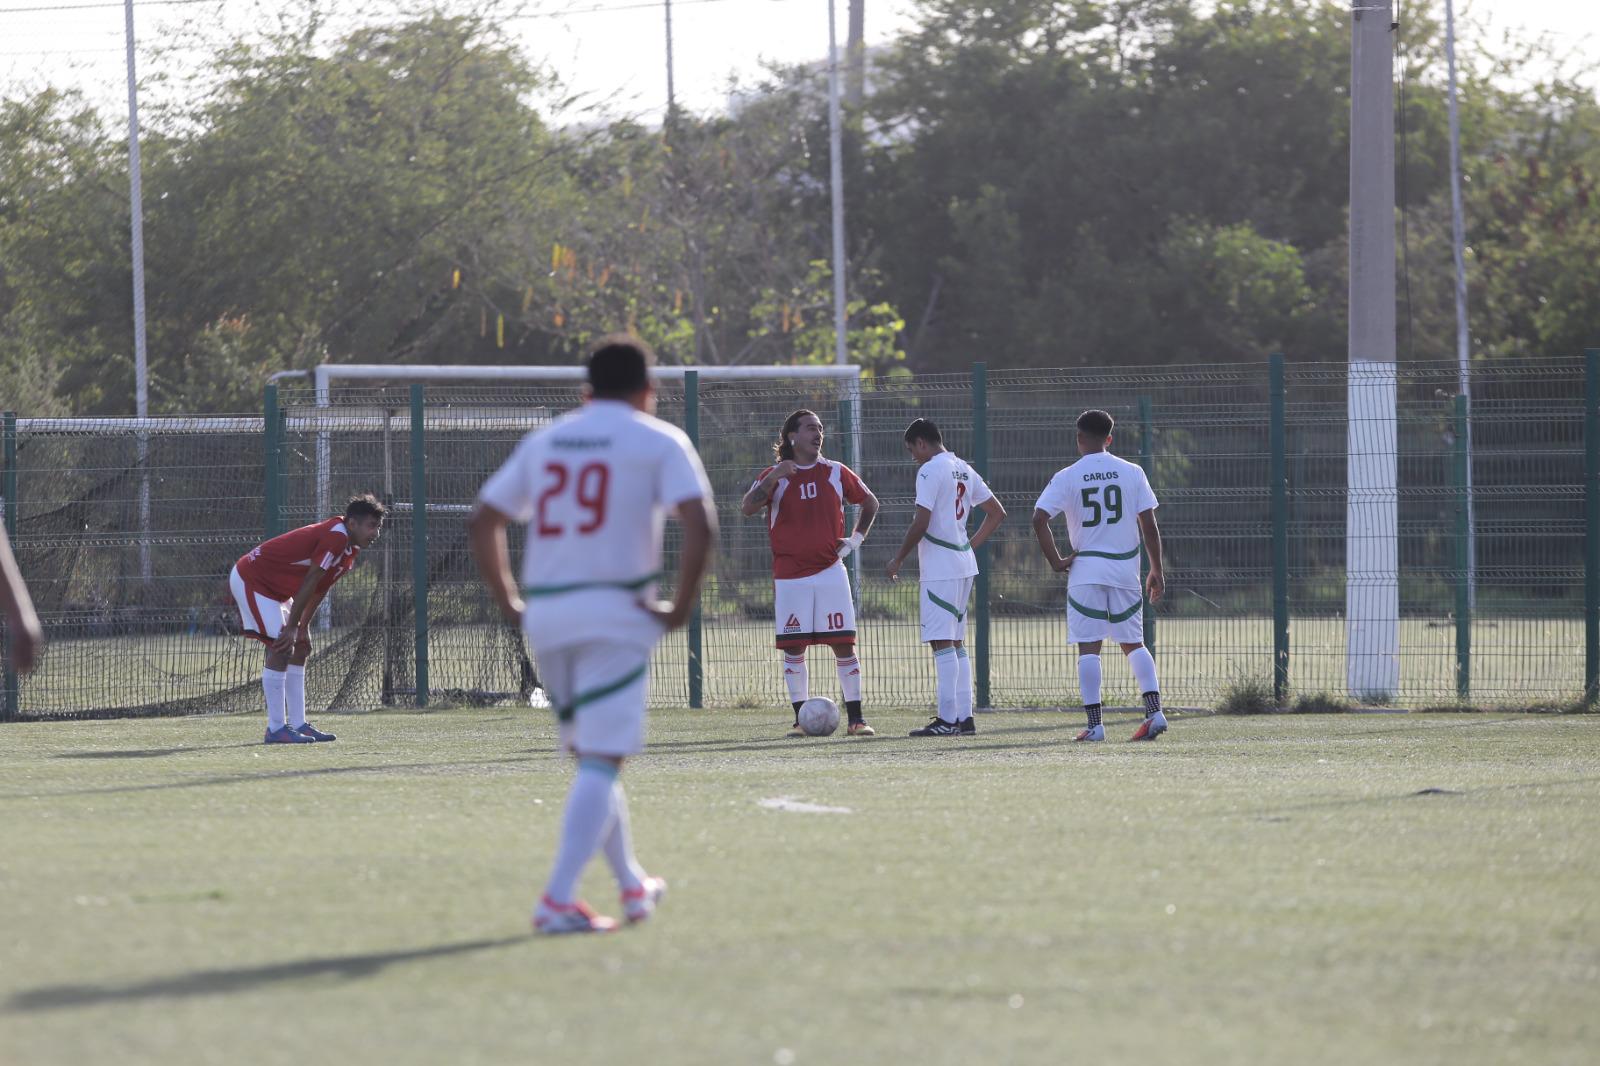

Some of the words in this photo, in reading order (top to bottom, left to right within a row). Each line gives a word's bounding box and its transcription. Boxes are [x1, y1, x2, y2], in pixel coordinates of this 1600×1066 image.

[800, 481, 817, 499] 10
[1083, 471, 1119, 482] CARLOS
[538, 462, 610, 536] 29
[955, 481, 966, 520] 8
[1081, 484, 1122, 527] 59
[827, 612, 844, 630] 10
